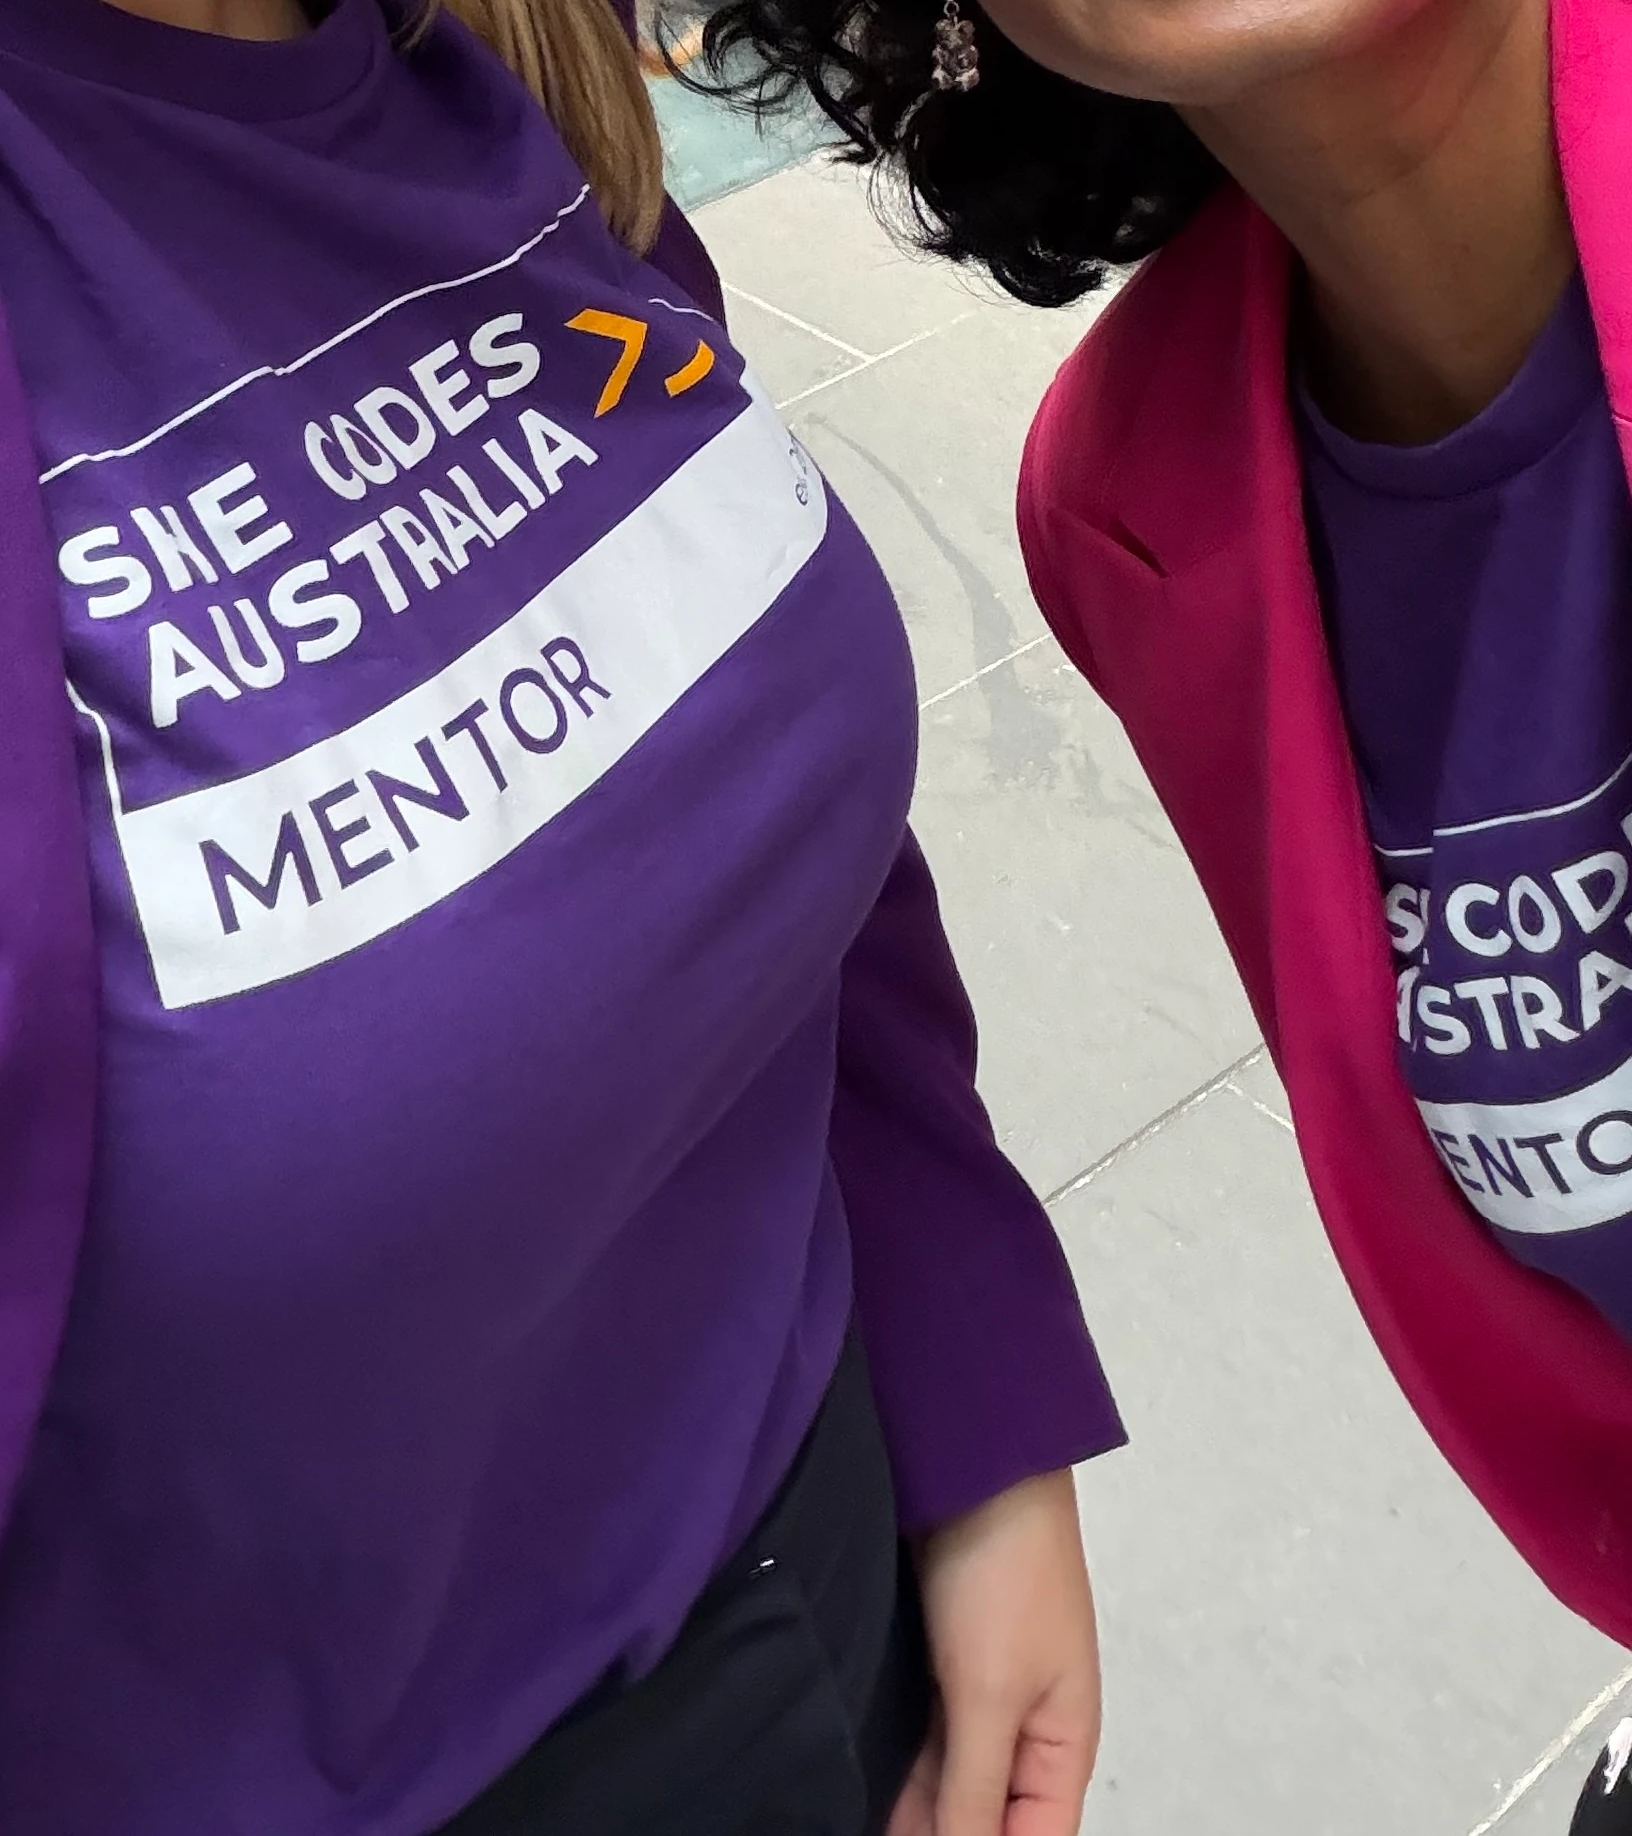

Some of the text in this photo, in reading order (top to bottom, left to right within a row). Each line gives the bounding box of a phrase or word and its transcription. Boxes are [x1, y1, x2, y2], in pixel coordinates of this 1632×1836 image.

[58, 312, 541, 619] SHE CODES
[148, 406, 598, 727] AUSTRALIA
[199, 634, 613, 935] MENTOR
